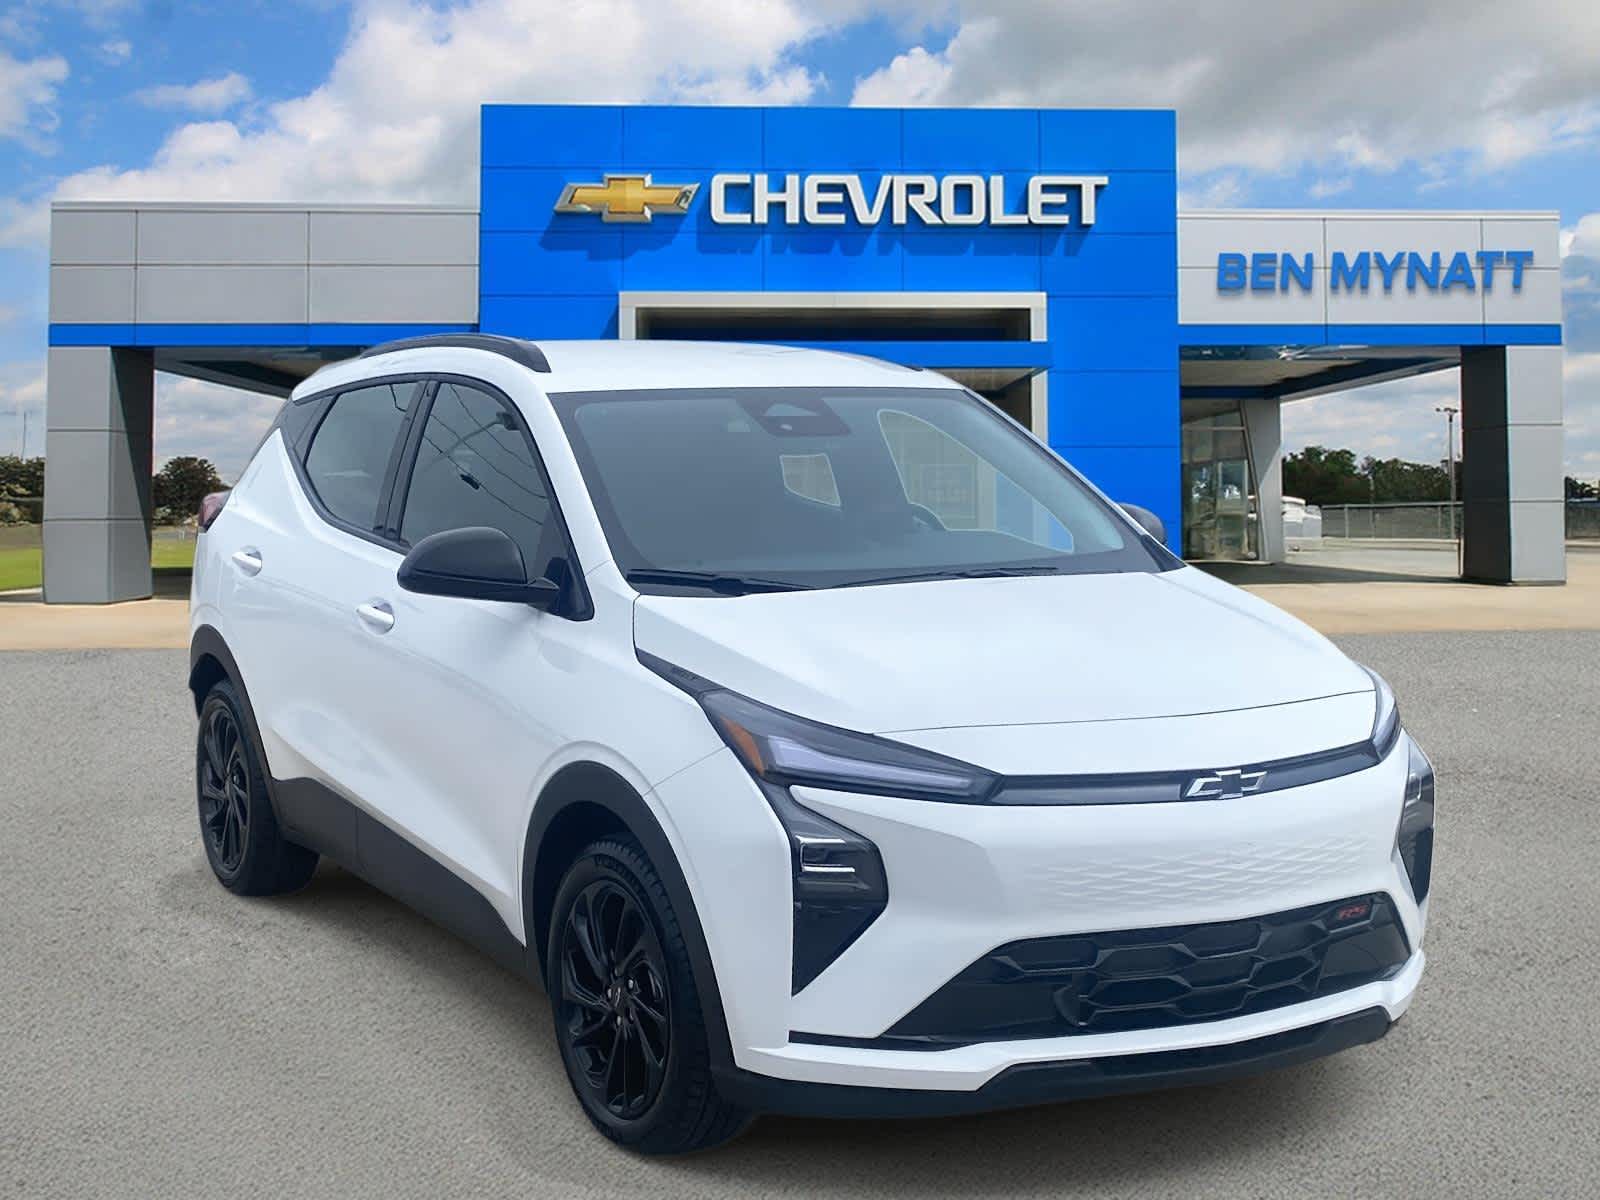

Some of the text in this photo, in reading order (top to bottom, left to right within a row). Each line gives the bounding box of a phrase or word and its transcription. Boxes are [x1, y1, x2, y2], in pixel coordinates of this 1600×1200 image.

[710, 174, 1109, 225] CHEVROLET
[1217, 250, 1534, 290] BEN MYNATT
